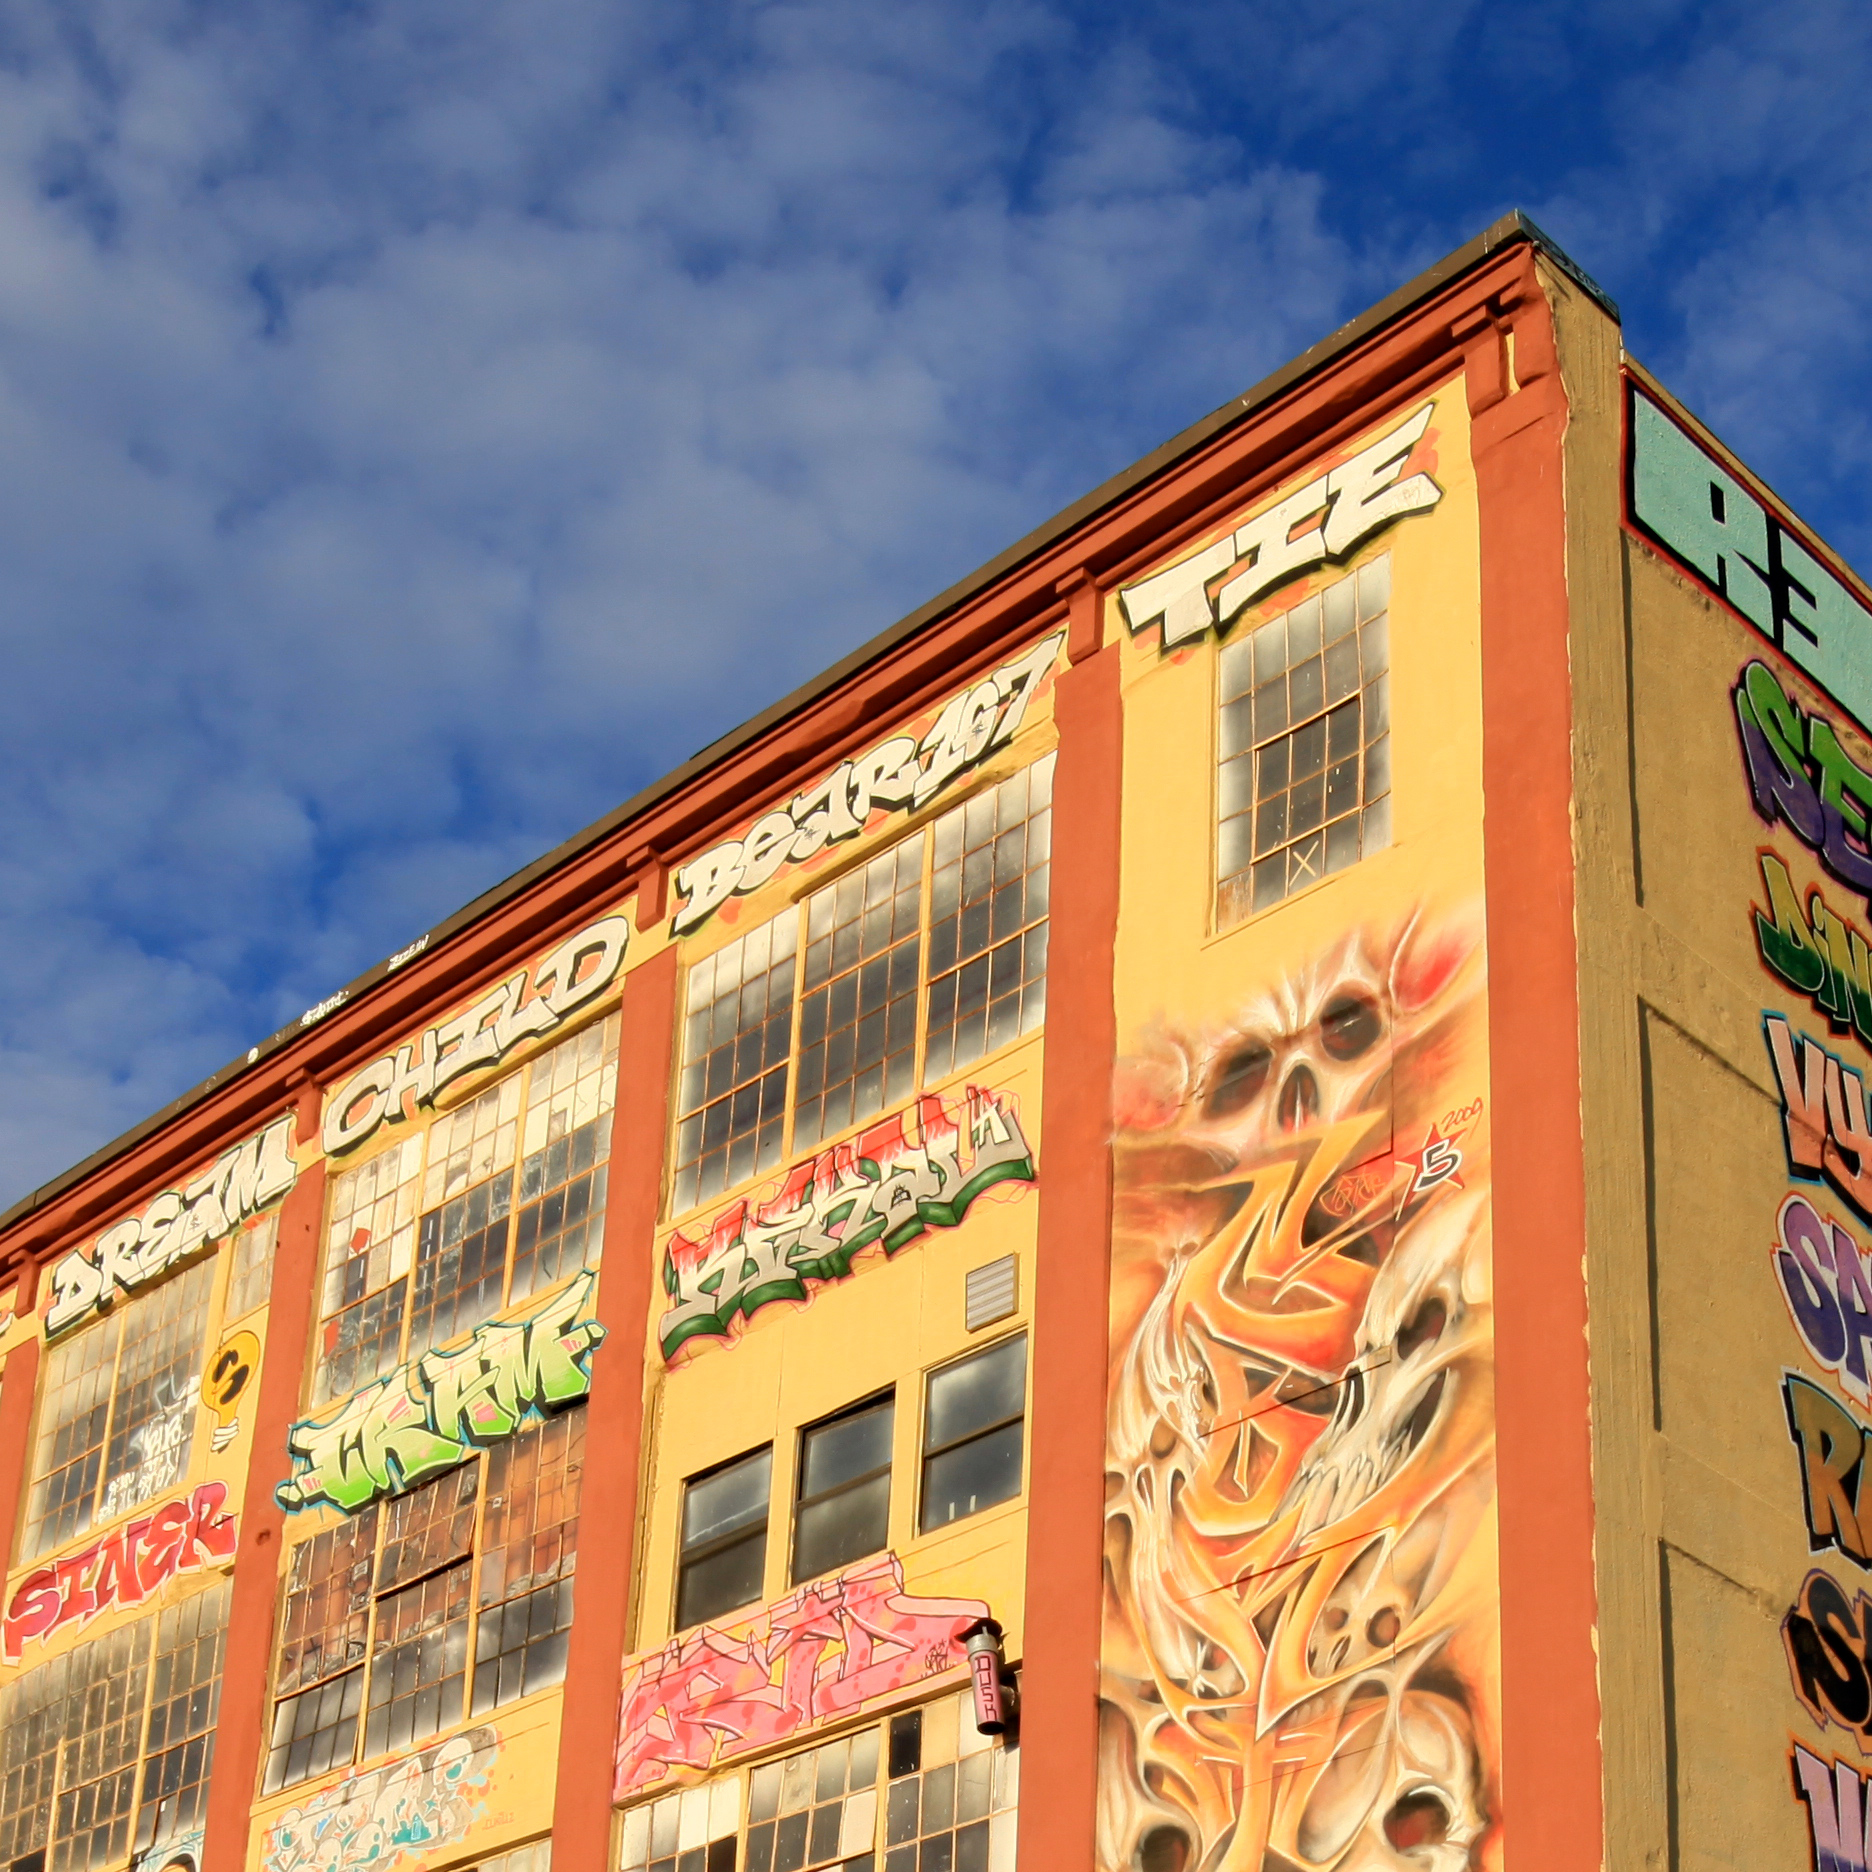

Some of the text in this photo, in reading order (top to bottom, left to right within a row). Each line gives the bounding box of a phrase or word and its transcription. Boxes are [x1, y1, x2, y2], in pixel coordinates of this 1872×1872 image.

[1118, 399, 1444, 660] TIE
[323, 916, 629, 1158] CHILD
[1441, 1097, 1483, 1141] 2009
[45, 1114, 297, 1338] DREAM
[974, 1656, 999, 1722] DUSK
